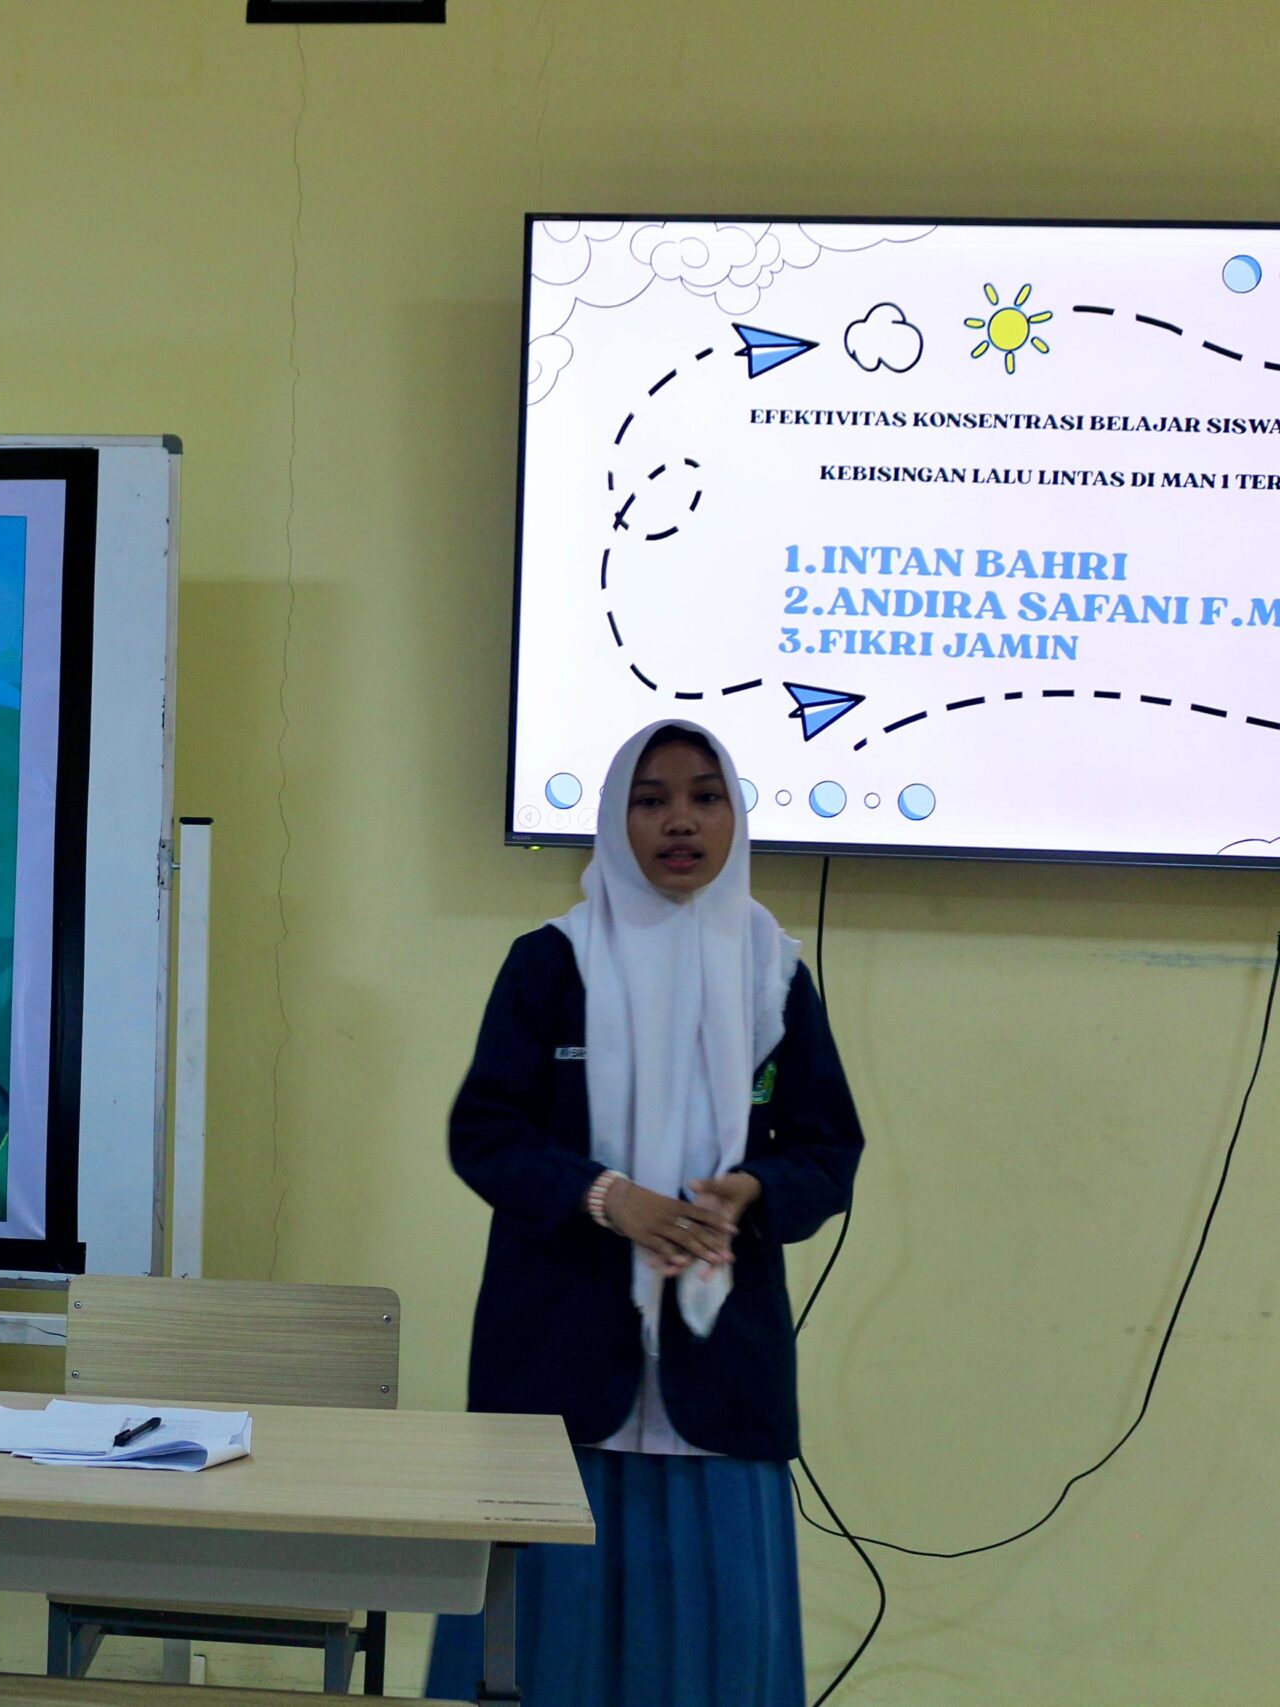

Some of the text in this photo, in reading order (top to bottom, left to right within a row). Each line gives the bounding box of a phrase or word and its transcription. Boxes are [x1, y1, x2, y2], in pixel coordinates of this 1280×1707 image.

[750, 409, 1280, 434] EFEKTIVITAS KONSENTRASI BELAJAR SISWA
[820, 465, 1280, 490] KEBISINGAN LALU LINTAS DI MAN 1 TER
[975, 550, 1128, 581] BAHRI
[1017, 592, 1189, 625] SAFANI
[942, 632, 1079, 661] JAMIN
